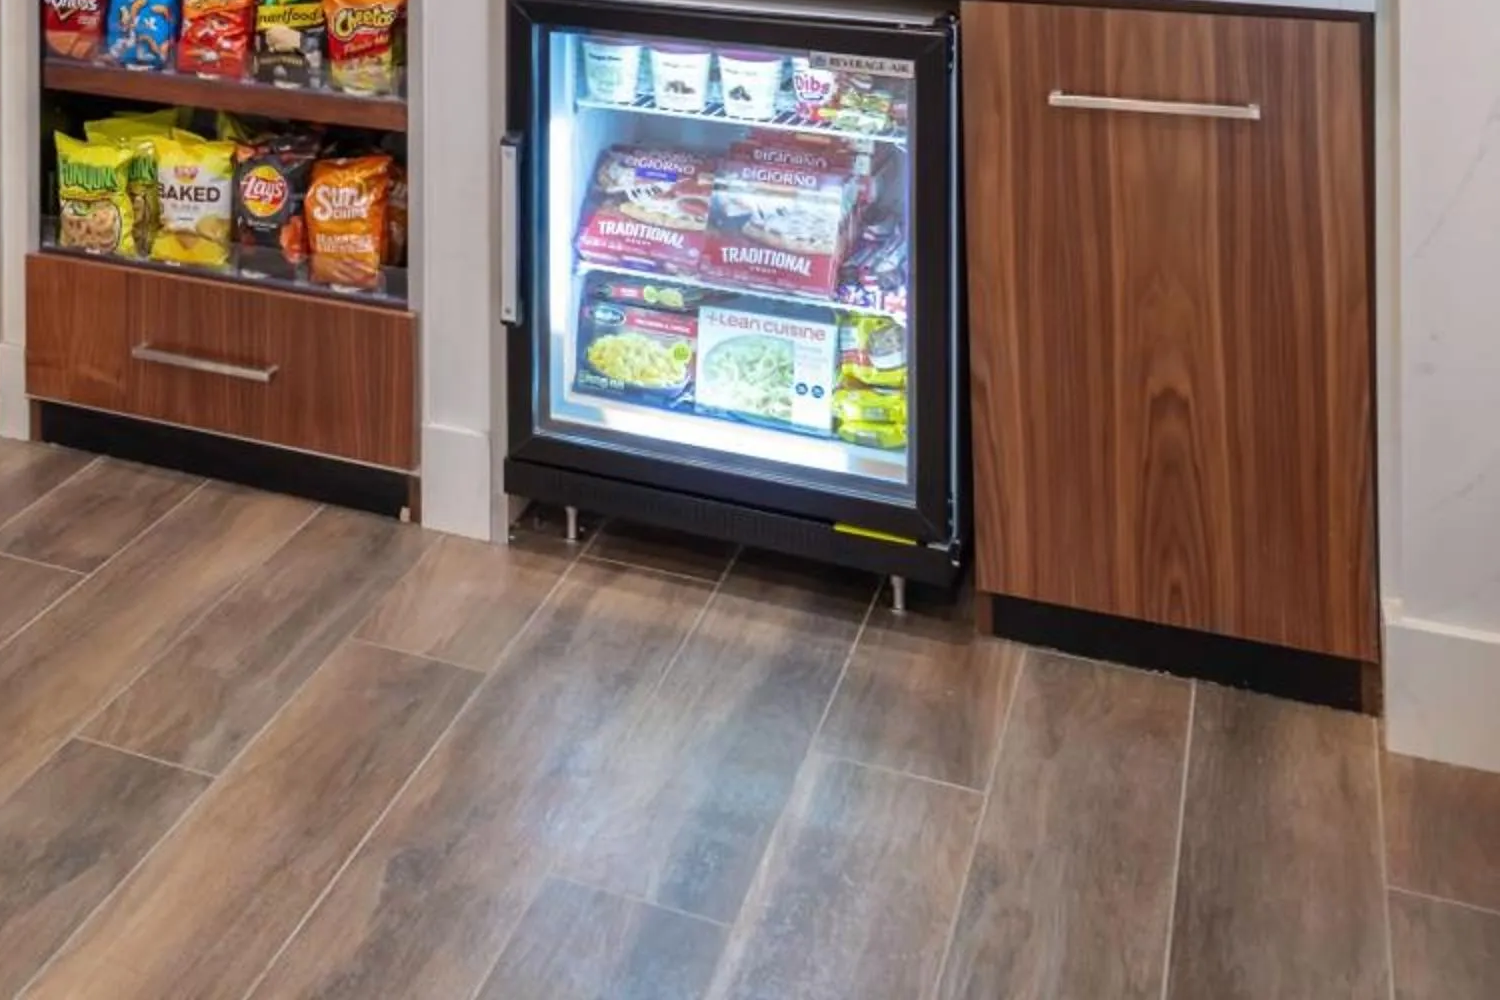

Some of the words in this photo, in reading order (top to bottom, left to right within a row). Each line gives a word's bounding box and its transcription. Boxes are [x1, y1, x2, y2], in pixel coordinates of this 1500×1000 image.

[240, 176, 284, 201] Lay's
[742, 167, 818, 188] DIGIORNO
[597, 219, 685, 249] TRADITIONAL
[720, 247, 813, 277] TRADITIONAL
